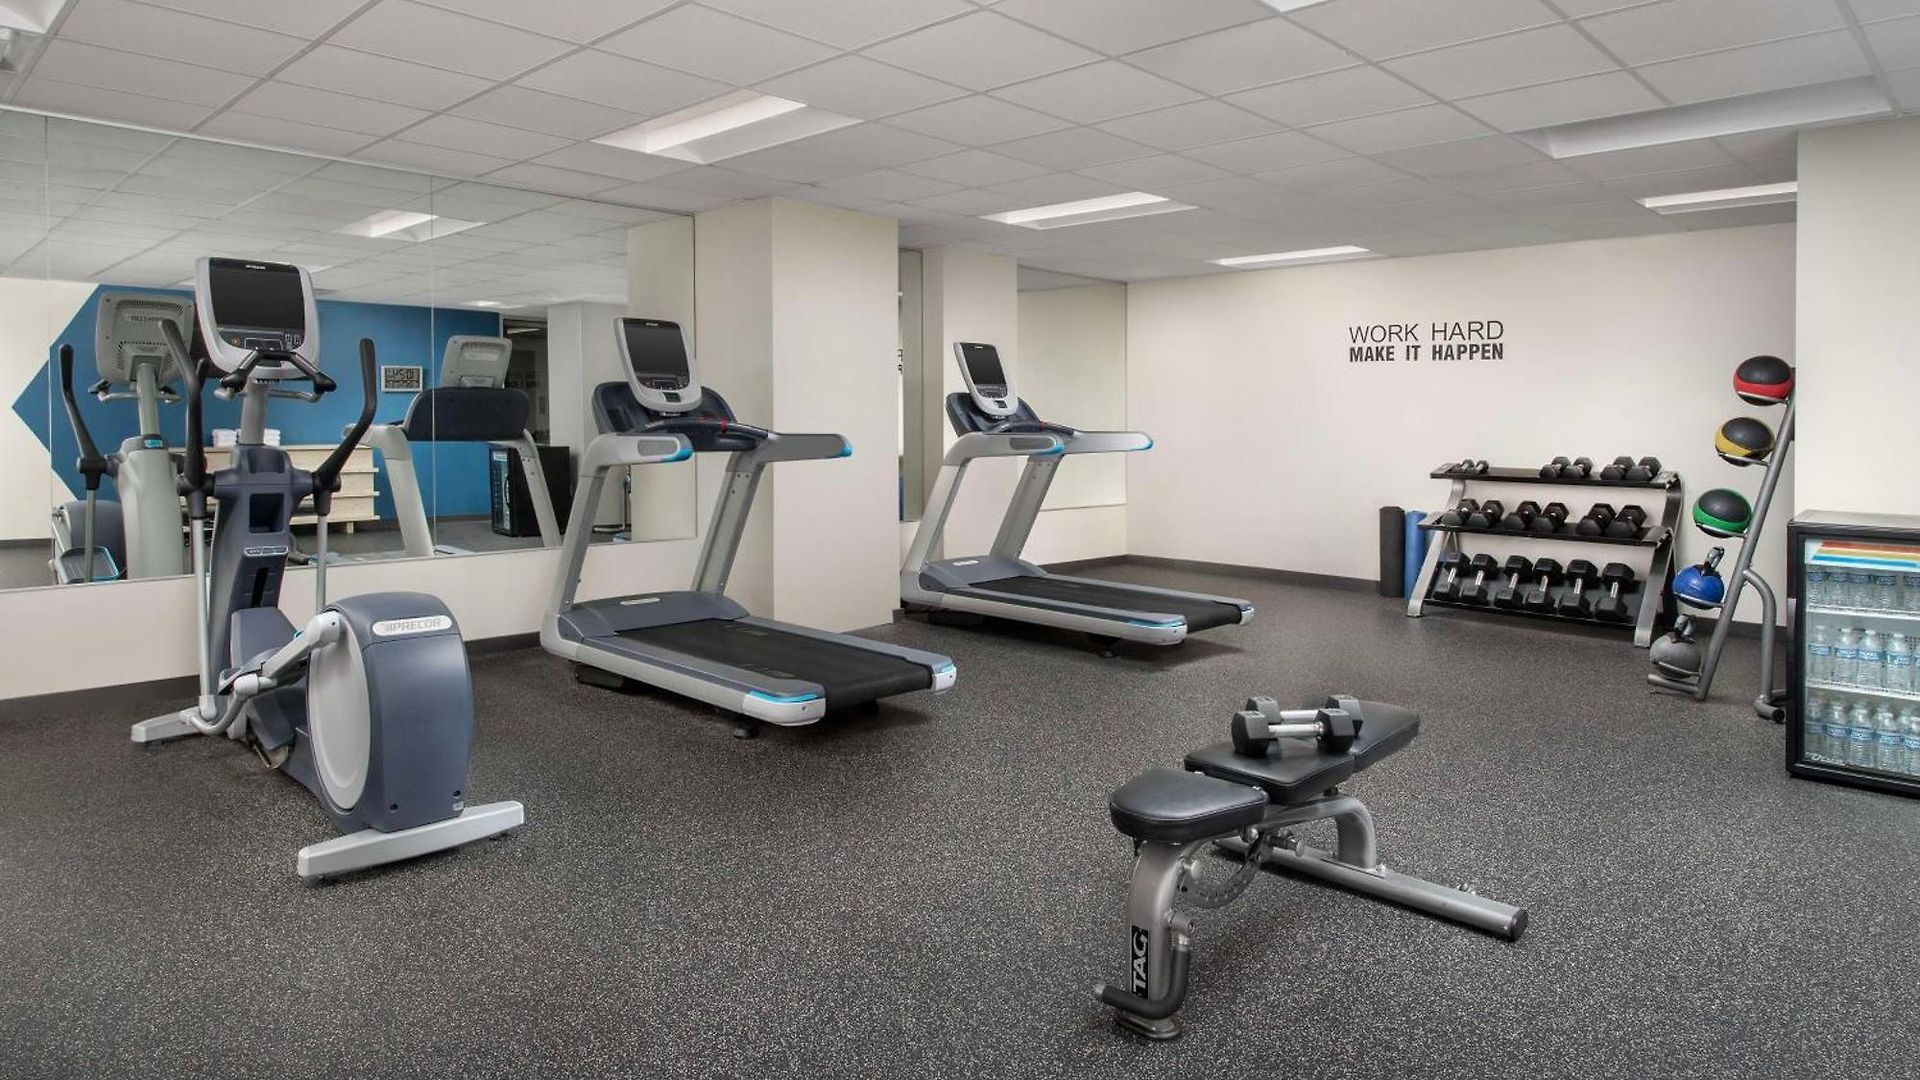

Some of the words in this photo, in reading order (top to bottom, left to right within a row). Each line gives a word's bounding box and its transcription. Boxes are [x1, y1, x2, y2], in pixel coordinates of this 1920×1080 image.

[1349, 323, 1419, 344] WORK
[1431, 320, 1504, 341] HARD
[1349, 345, 1395, 362] MAKE
[1405, 345, 1421, 361] IT
[1431, 343, 1504, 361] HAPPEN
[391, 617, 441, 632] PRECOR
[1132, 931, 1148, 993] TAG
